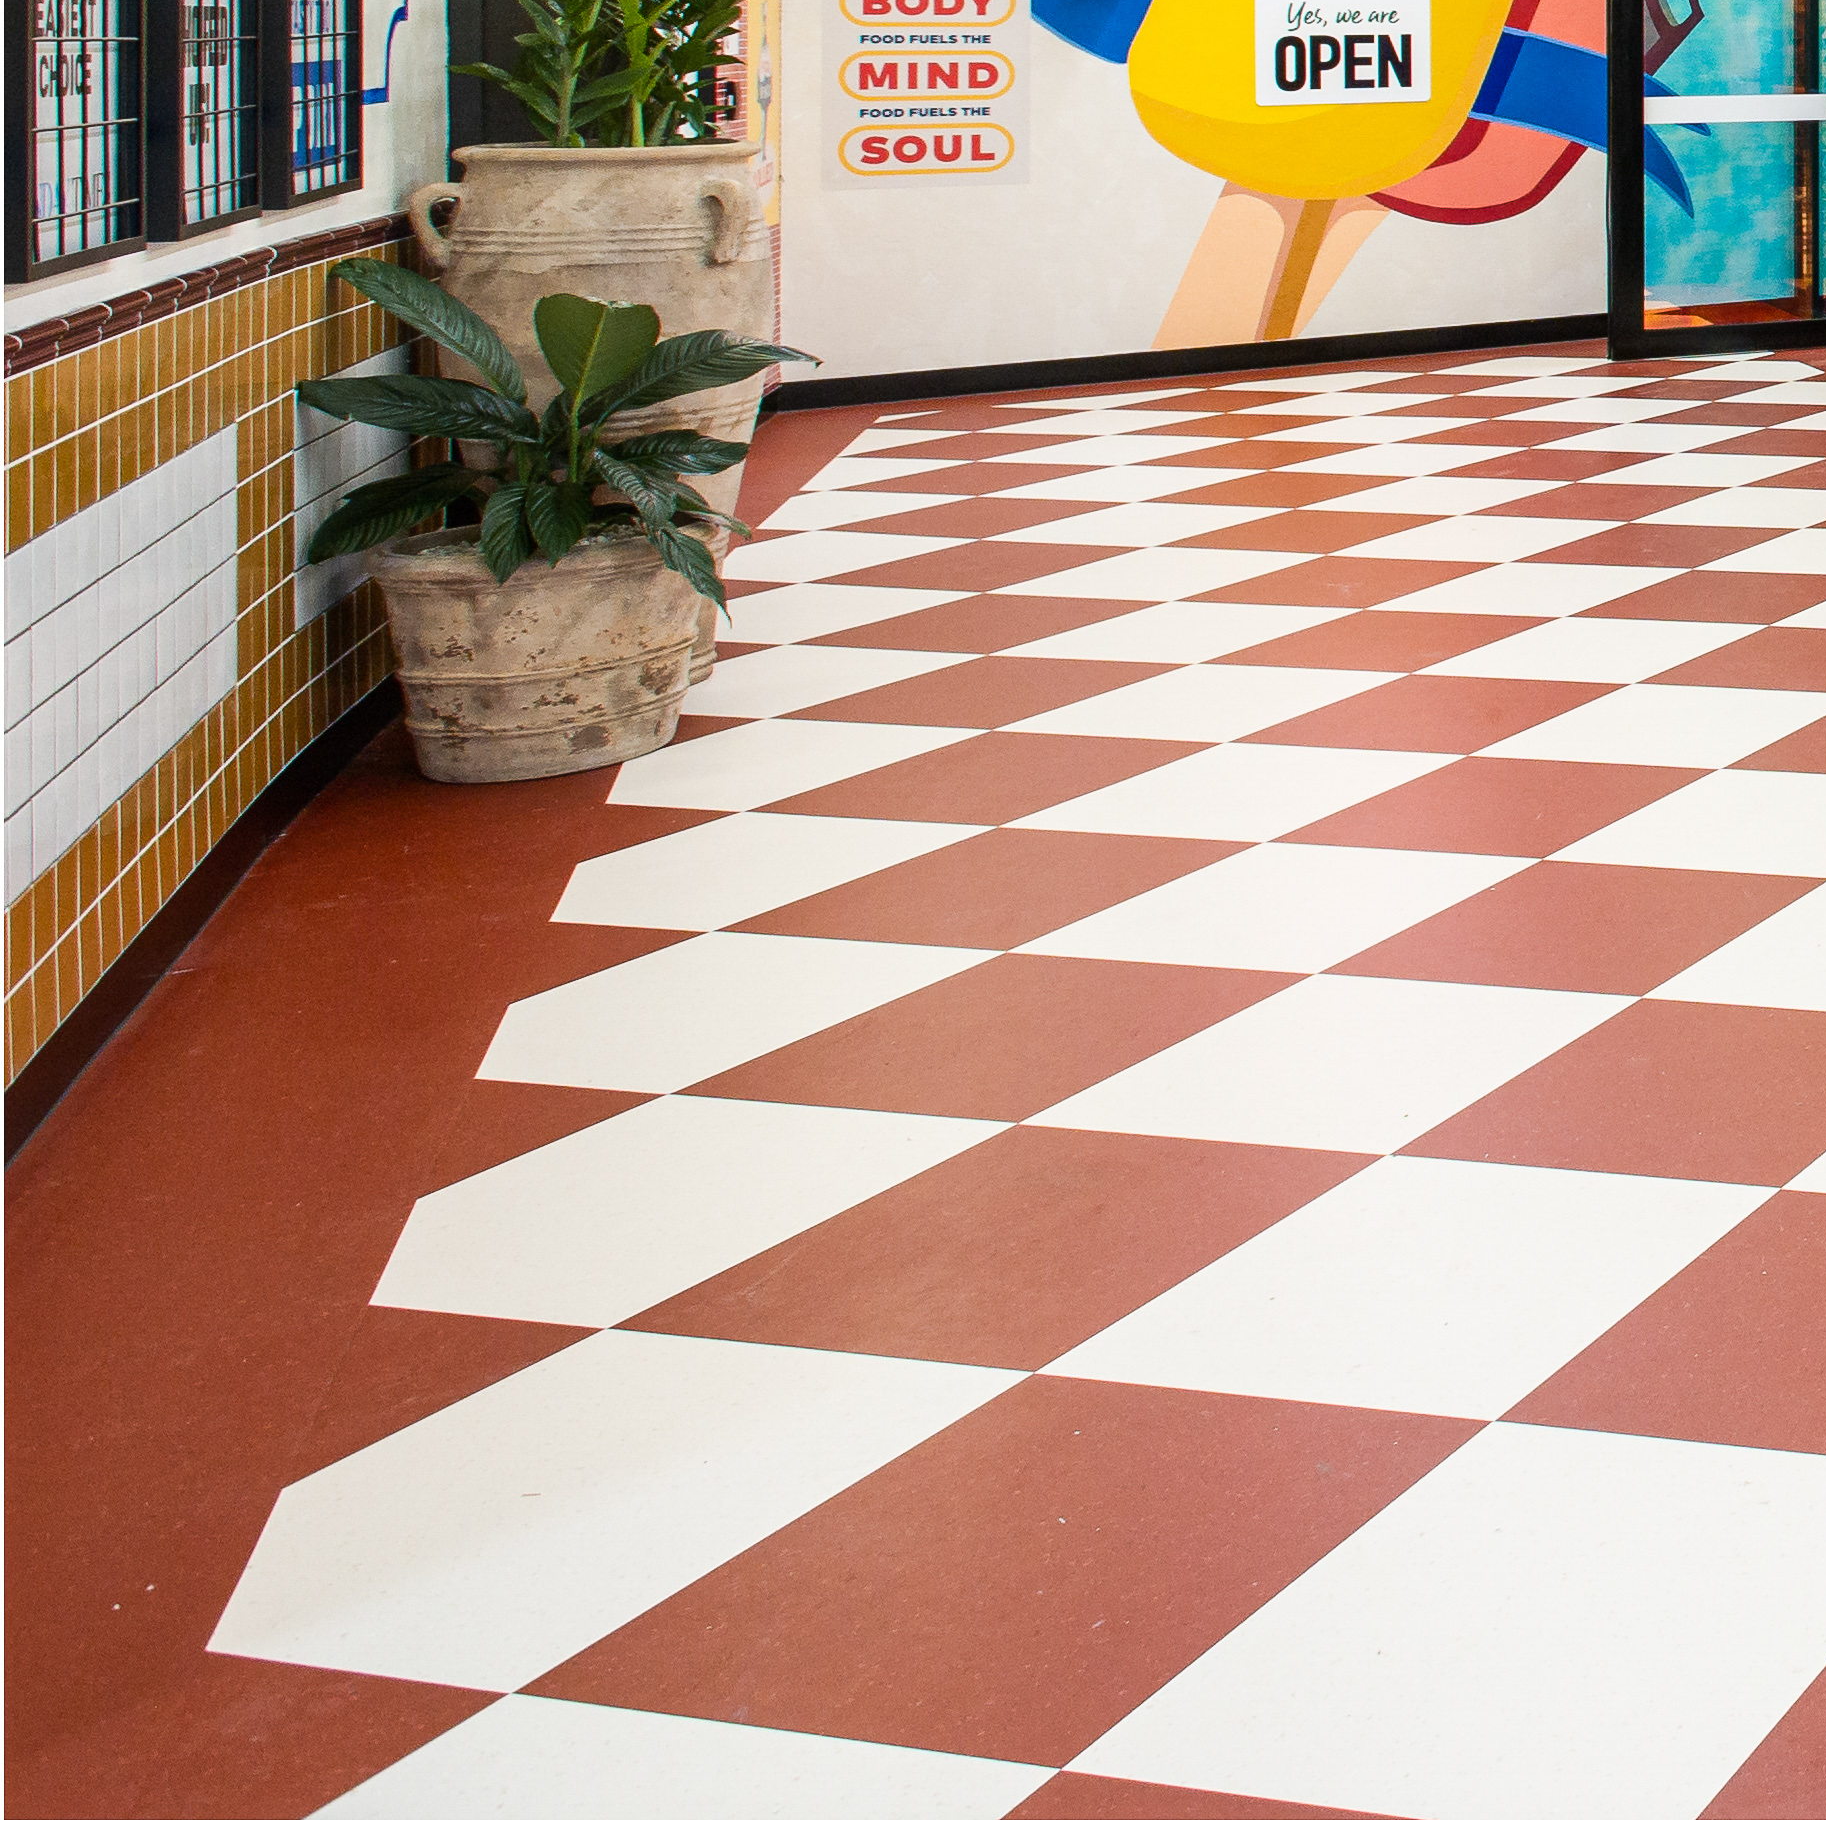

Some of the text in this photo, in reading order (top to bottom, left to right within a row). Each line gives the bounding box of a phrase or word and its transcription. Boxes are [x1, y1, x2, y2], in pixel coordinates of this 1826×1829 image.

[1287, 1, 1400, 32] Yes, we are
[860, 34, 992, 44] FOOD FUELS THE
[858, 61, 1000, 90] MIND
[1274, 33, 1413, 93] OPEN
[859, 106, 991, 119] FOOD FUELS THE
[860, 134, 996, 165] SOUL
